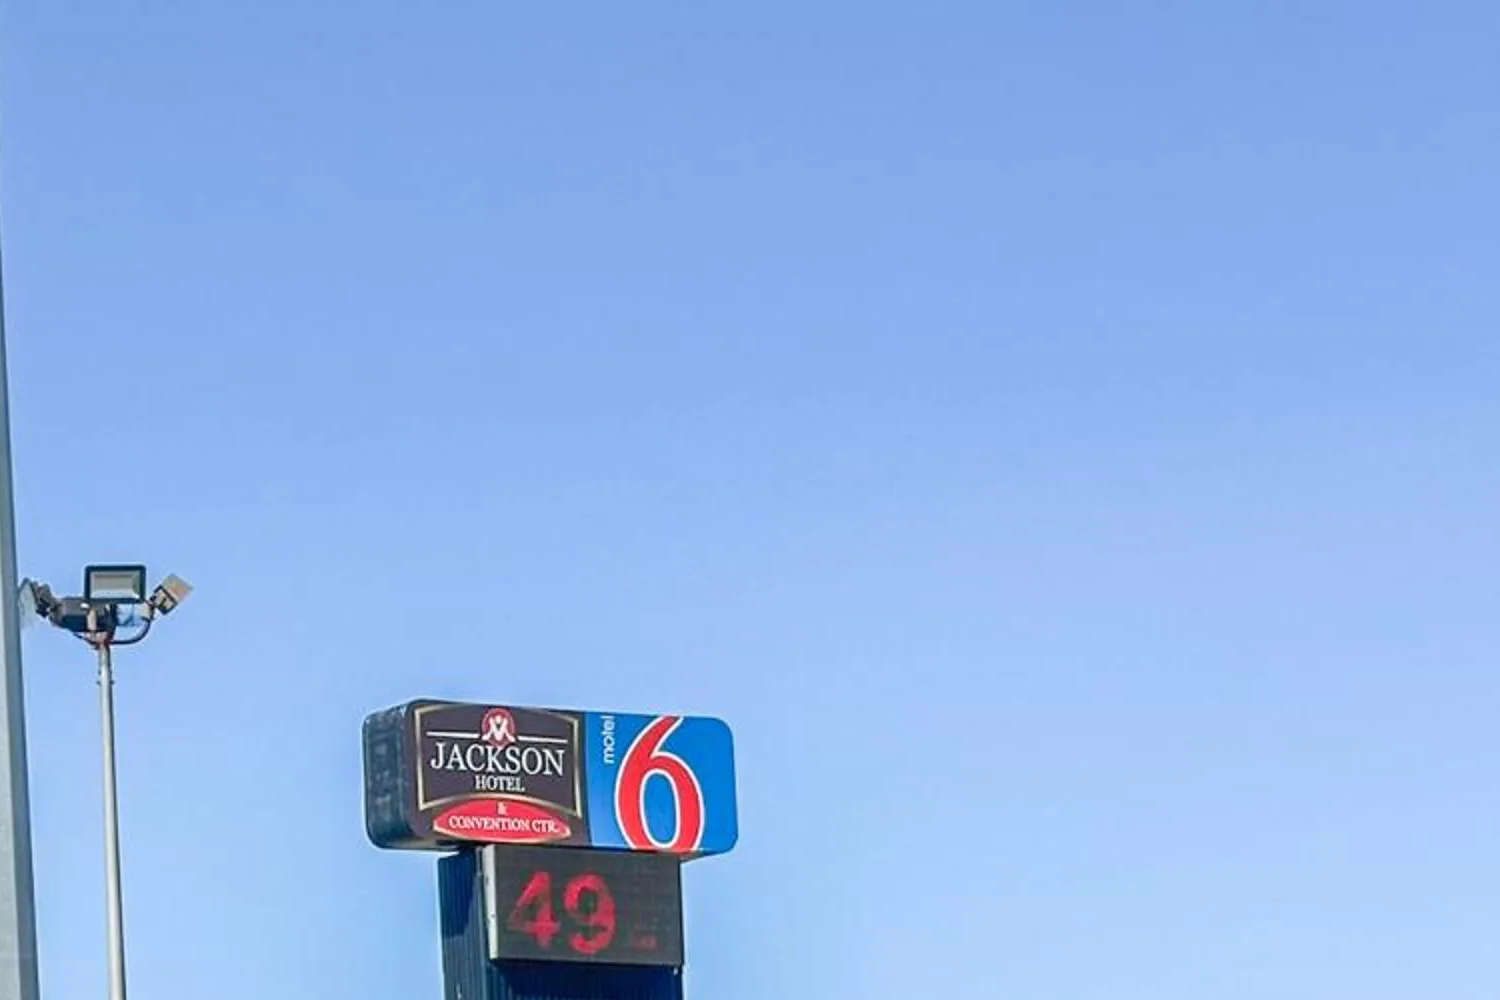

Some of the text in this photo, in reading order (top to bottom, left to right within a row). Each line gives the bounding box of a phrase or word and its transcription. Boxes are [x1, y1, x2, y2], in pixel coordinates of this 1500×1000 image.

[430, 742, 565, 776] JACKSON
[474, 775, 525, 792] HOTEL
[601, 715, 705, 854] motel 6
[448, 816, 530, 832] CONVENTION
[507, 871, 616, 955] 49
